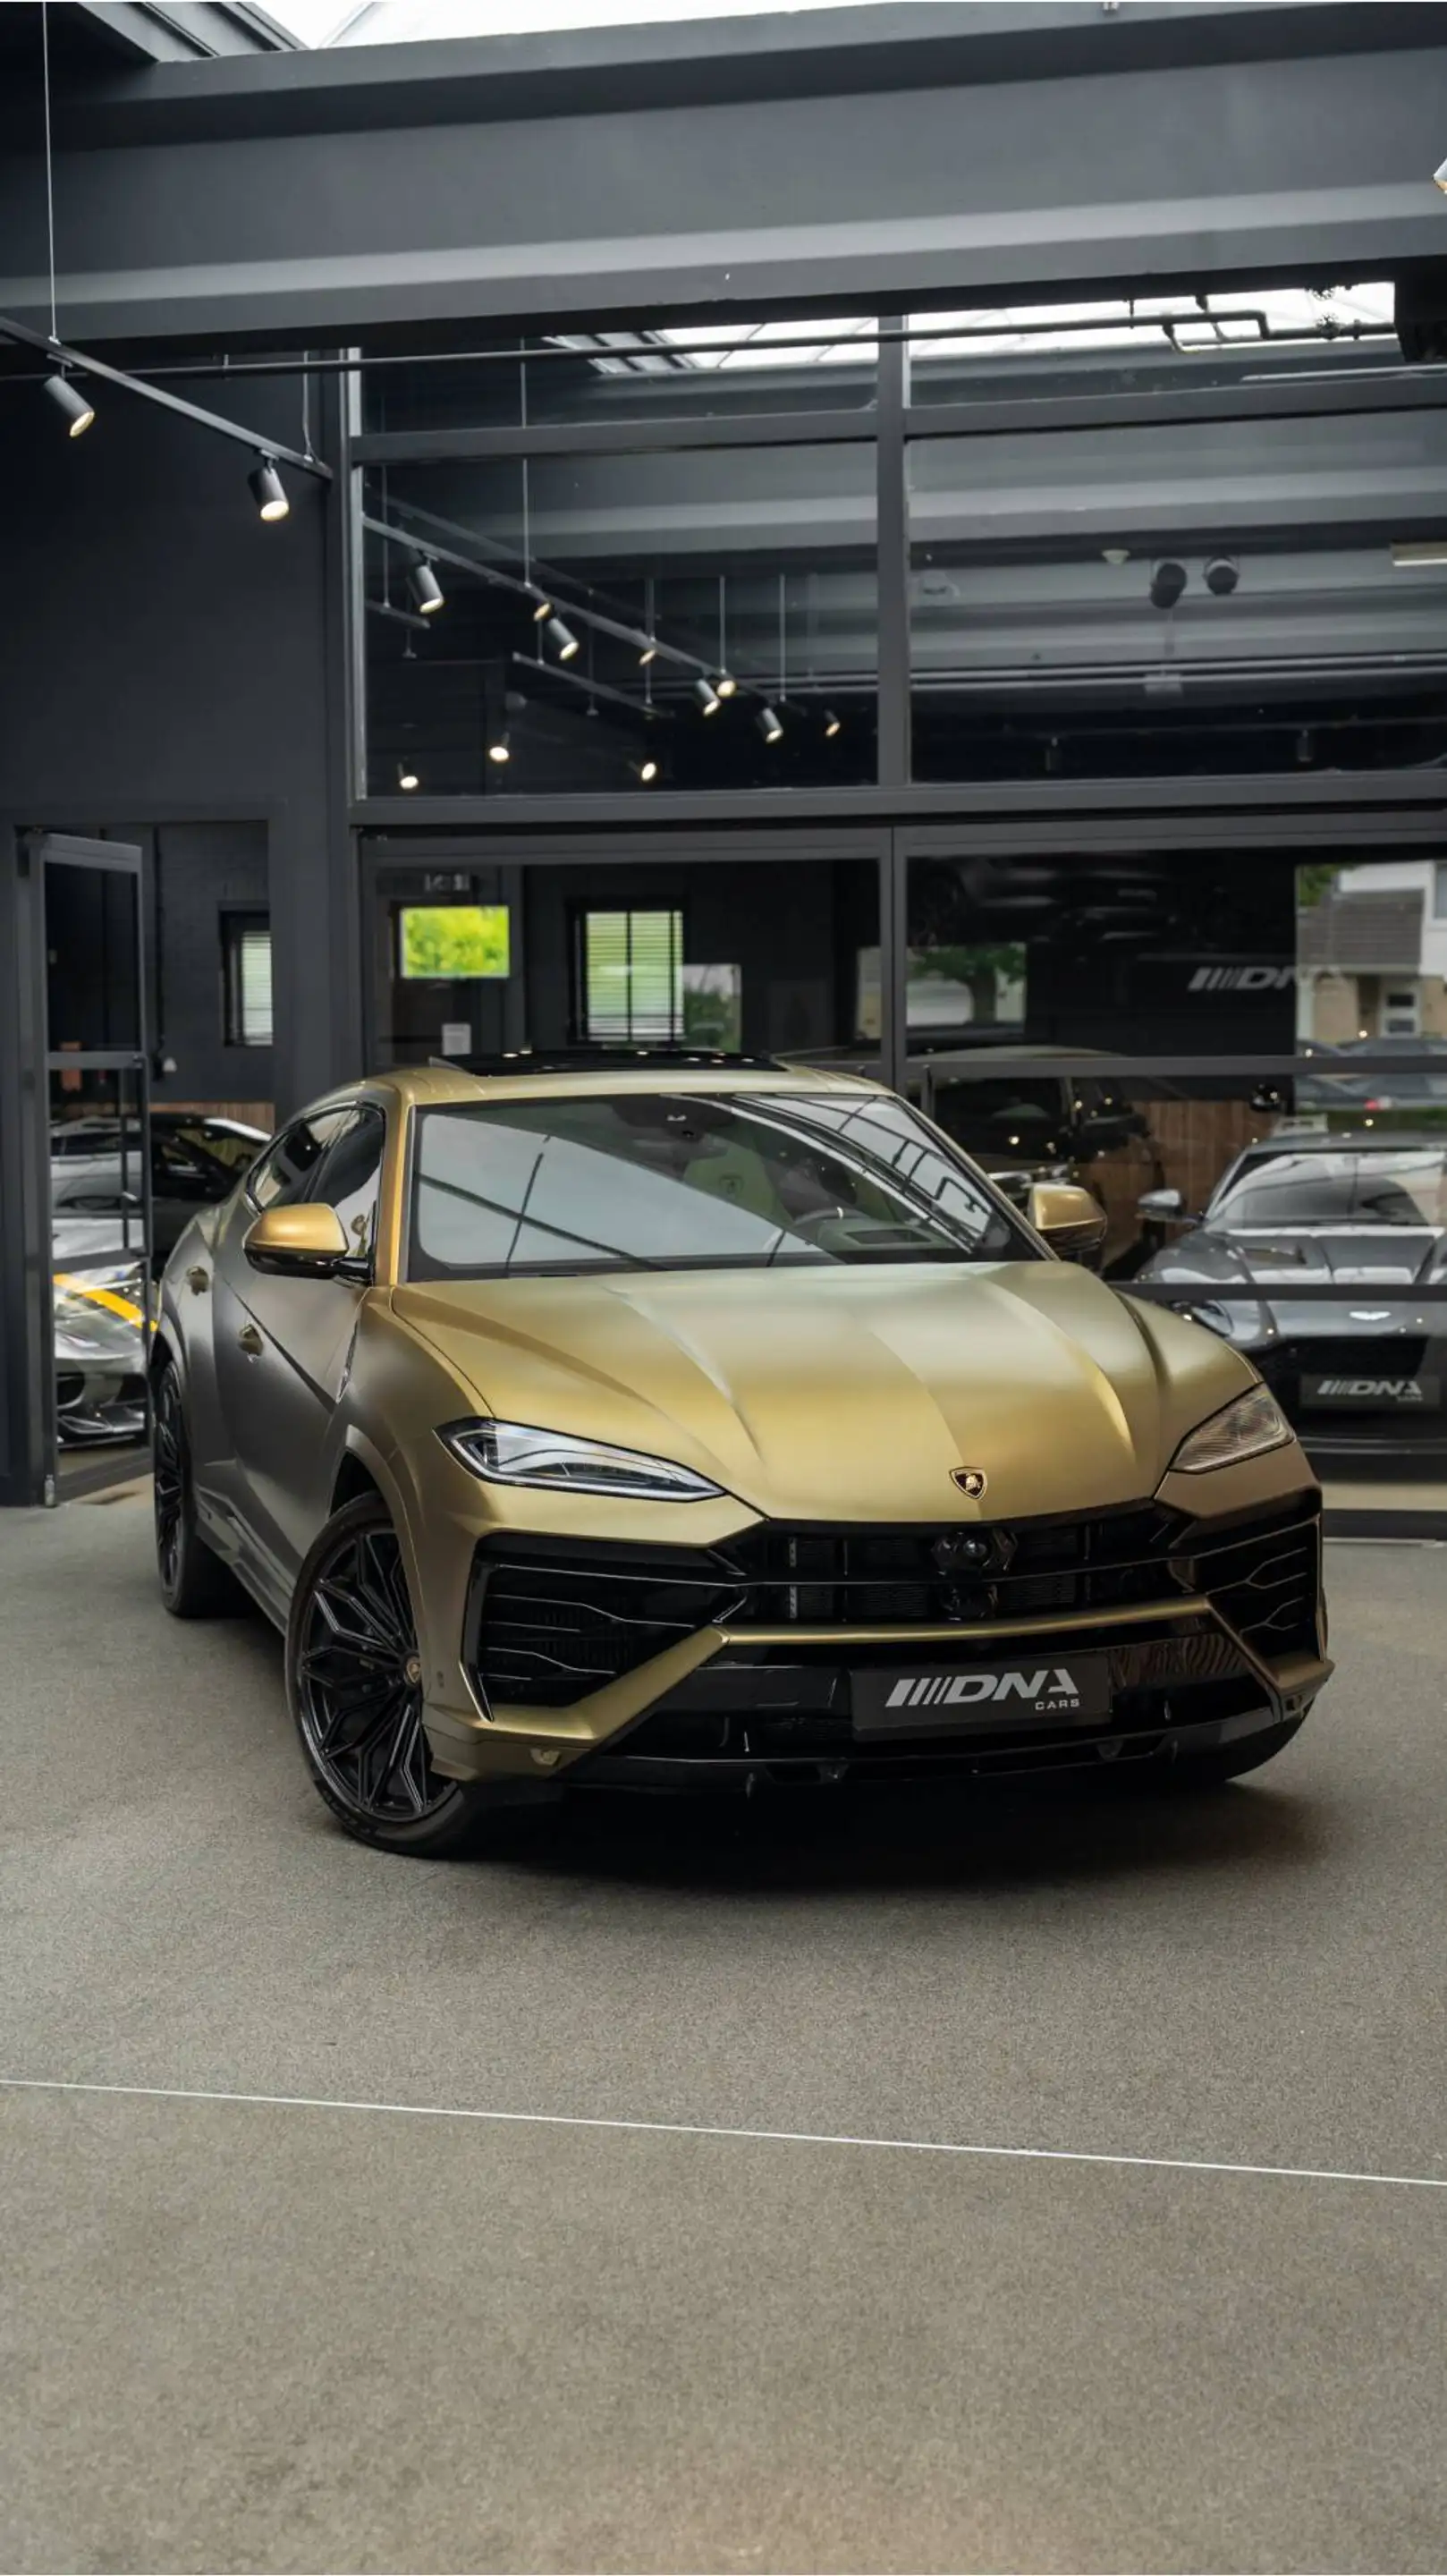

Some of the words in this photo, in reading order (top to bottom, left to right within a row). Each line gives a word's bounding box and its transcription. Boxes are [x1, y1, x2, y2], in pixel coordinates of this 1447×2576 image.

[1348, 1380, 1422, 1395] DNA
[943, 1668, 1079, 1704] DNA
[1035, 1699, 1080, 1710] CARS
